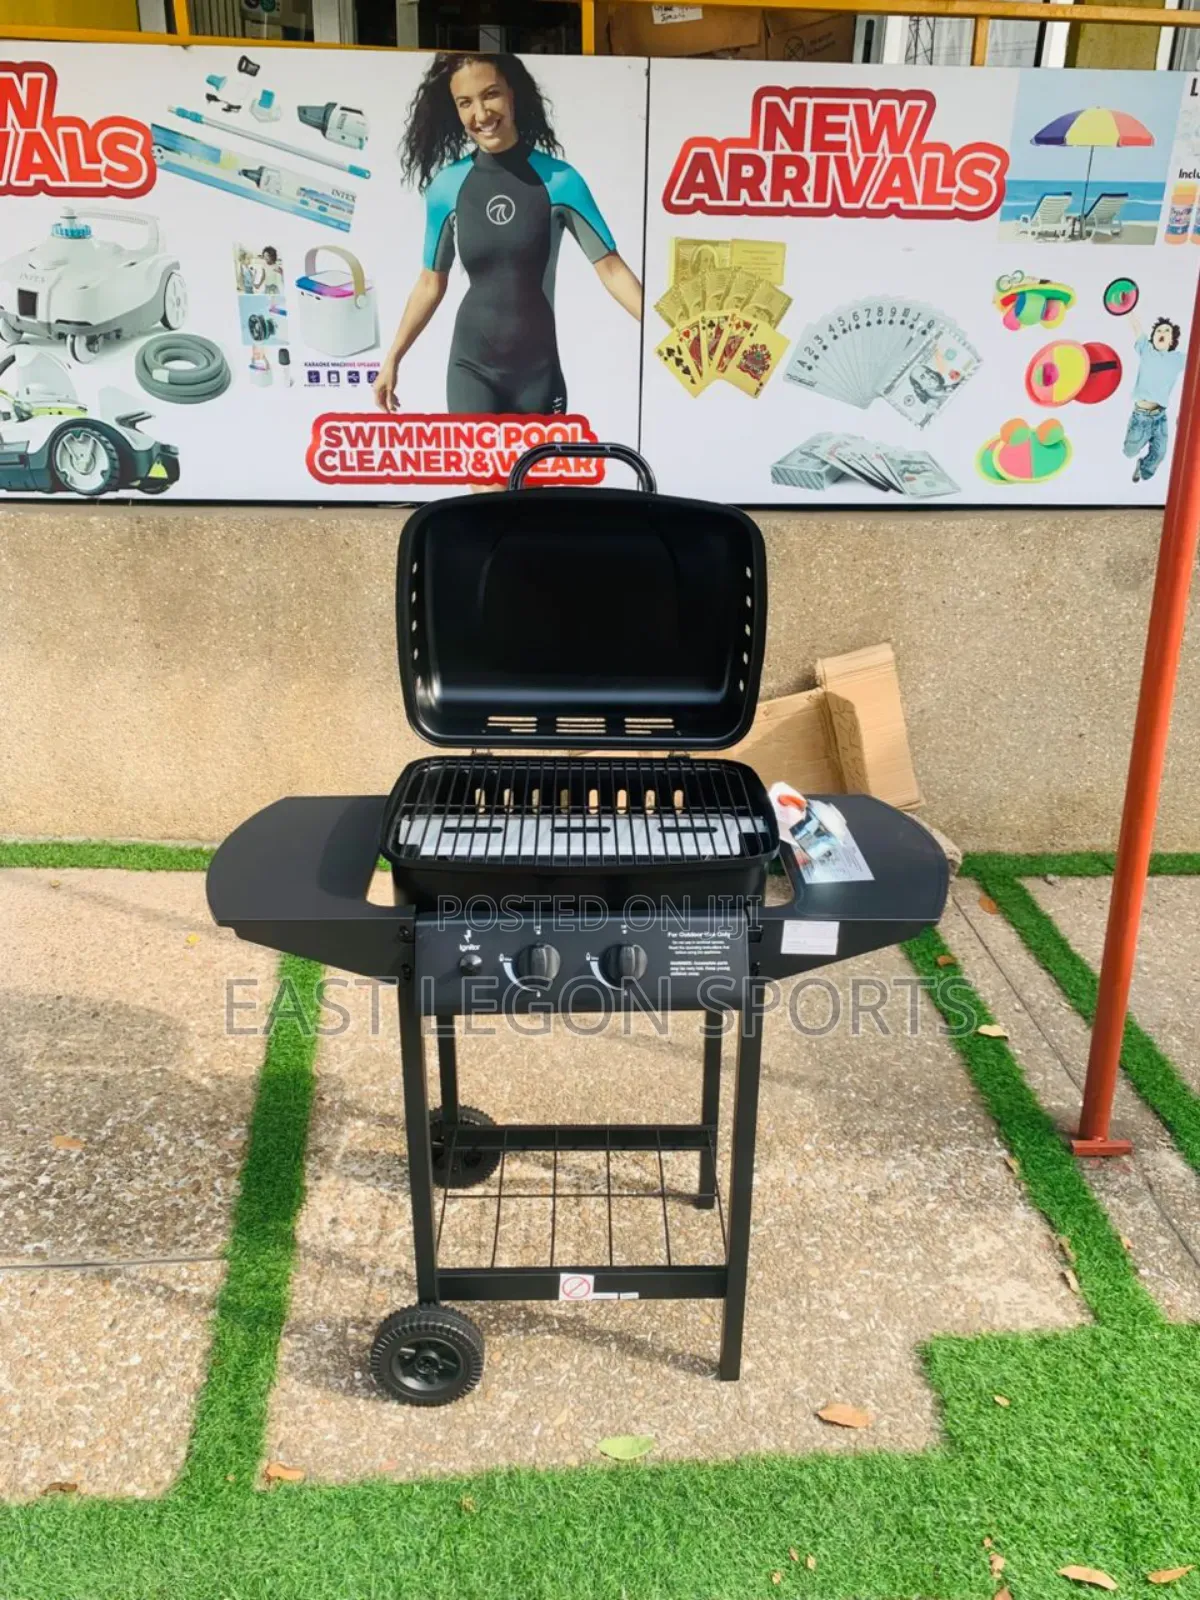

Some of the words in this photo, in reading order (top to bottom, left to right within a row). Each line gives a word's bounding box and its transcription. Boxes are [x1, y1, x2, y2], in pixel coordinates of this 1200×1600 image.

[759, 97, 926, 156] NEW
[671, 149, 999, 209] ARRIVALS
[331, 188, 357, 202] INTEX
[323, 425, 497, 449] SWIMMING
[317, 450, 465, 473] CLEANER
[471, 451, 489, 472] &
